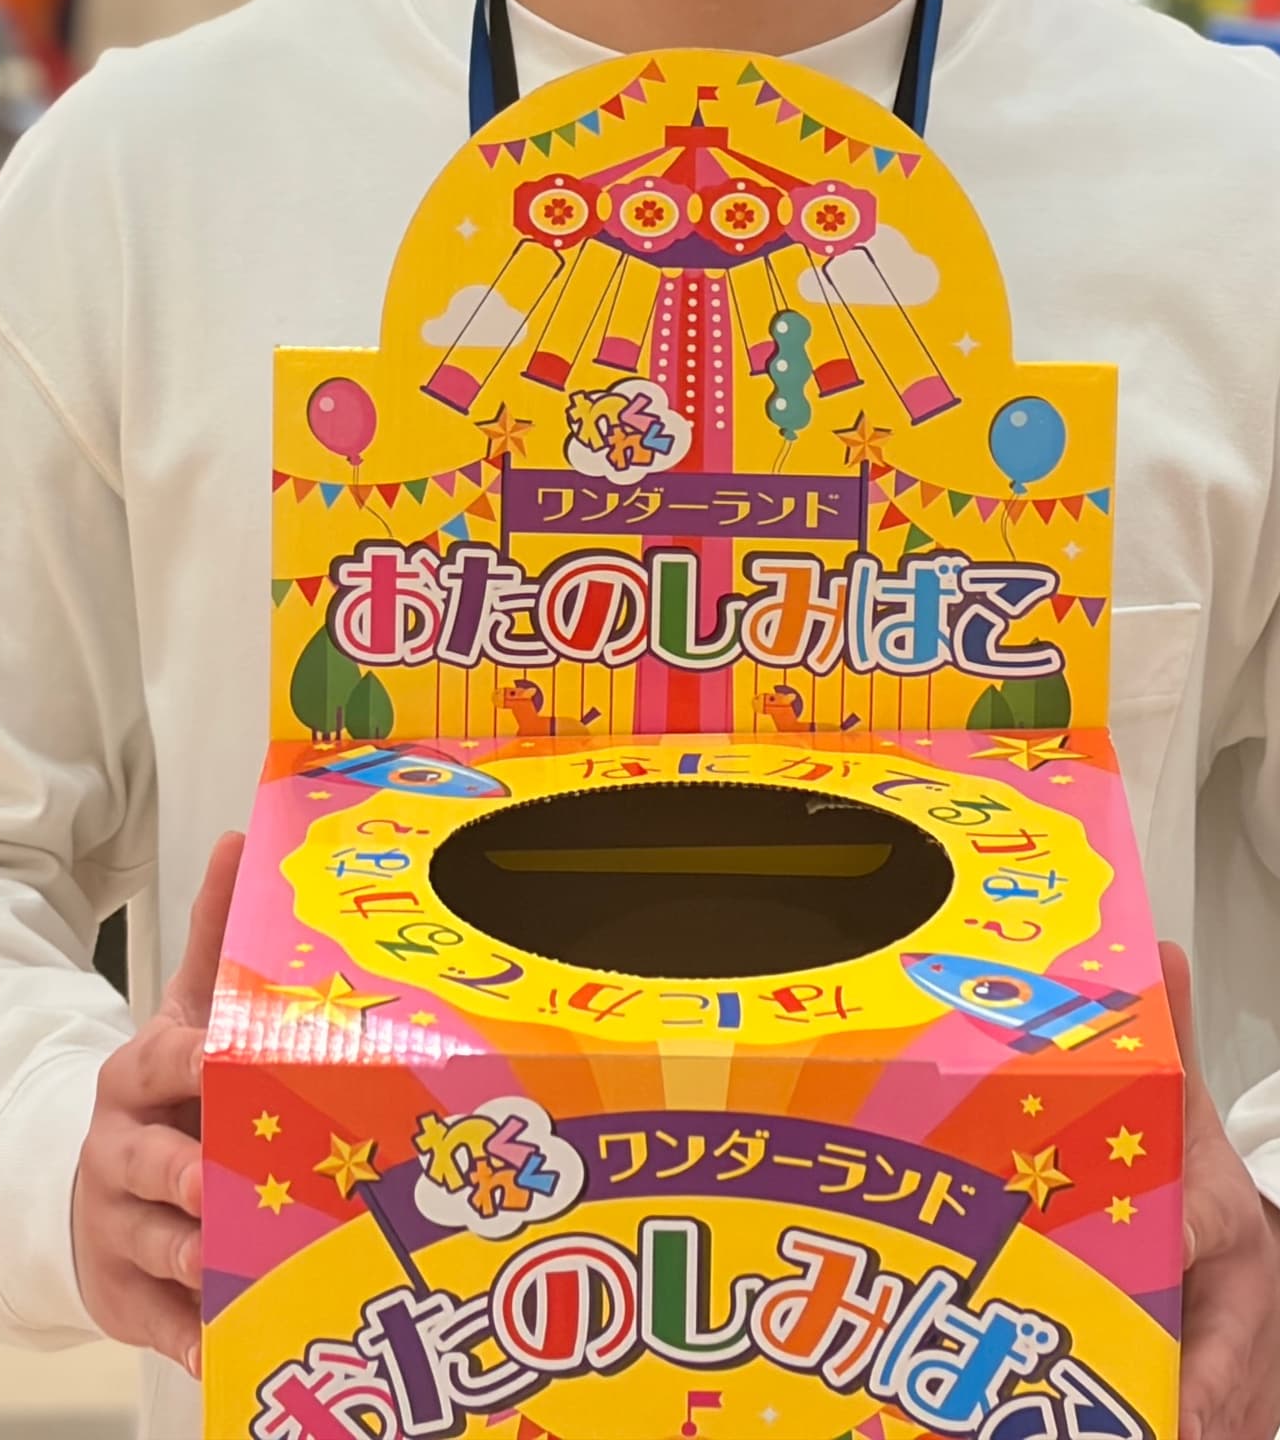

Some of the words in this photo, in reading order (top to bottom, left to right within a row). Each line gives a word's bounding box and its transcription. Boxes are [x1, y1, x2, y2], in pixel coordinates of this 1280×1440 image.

[565, 390, 676, 472] わくわく
[535, 485, 841, 530] ワンダーランド
[330, 542, 1066, 677] おたのしみばこ
[568, 752, 1070, 943] なにがでるかな？
[415, 1110, 561, 1219] わくわく
[597, 1127, 977, 1225] ワンダーランド
